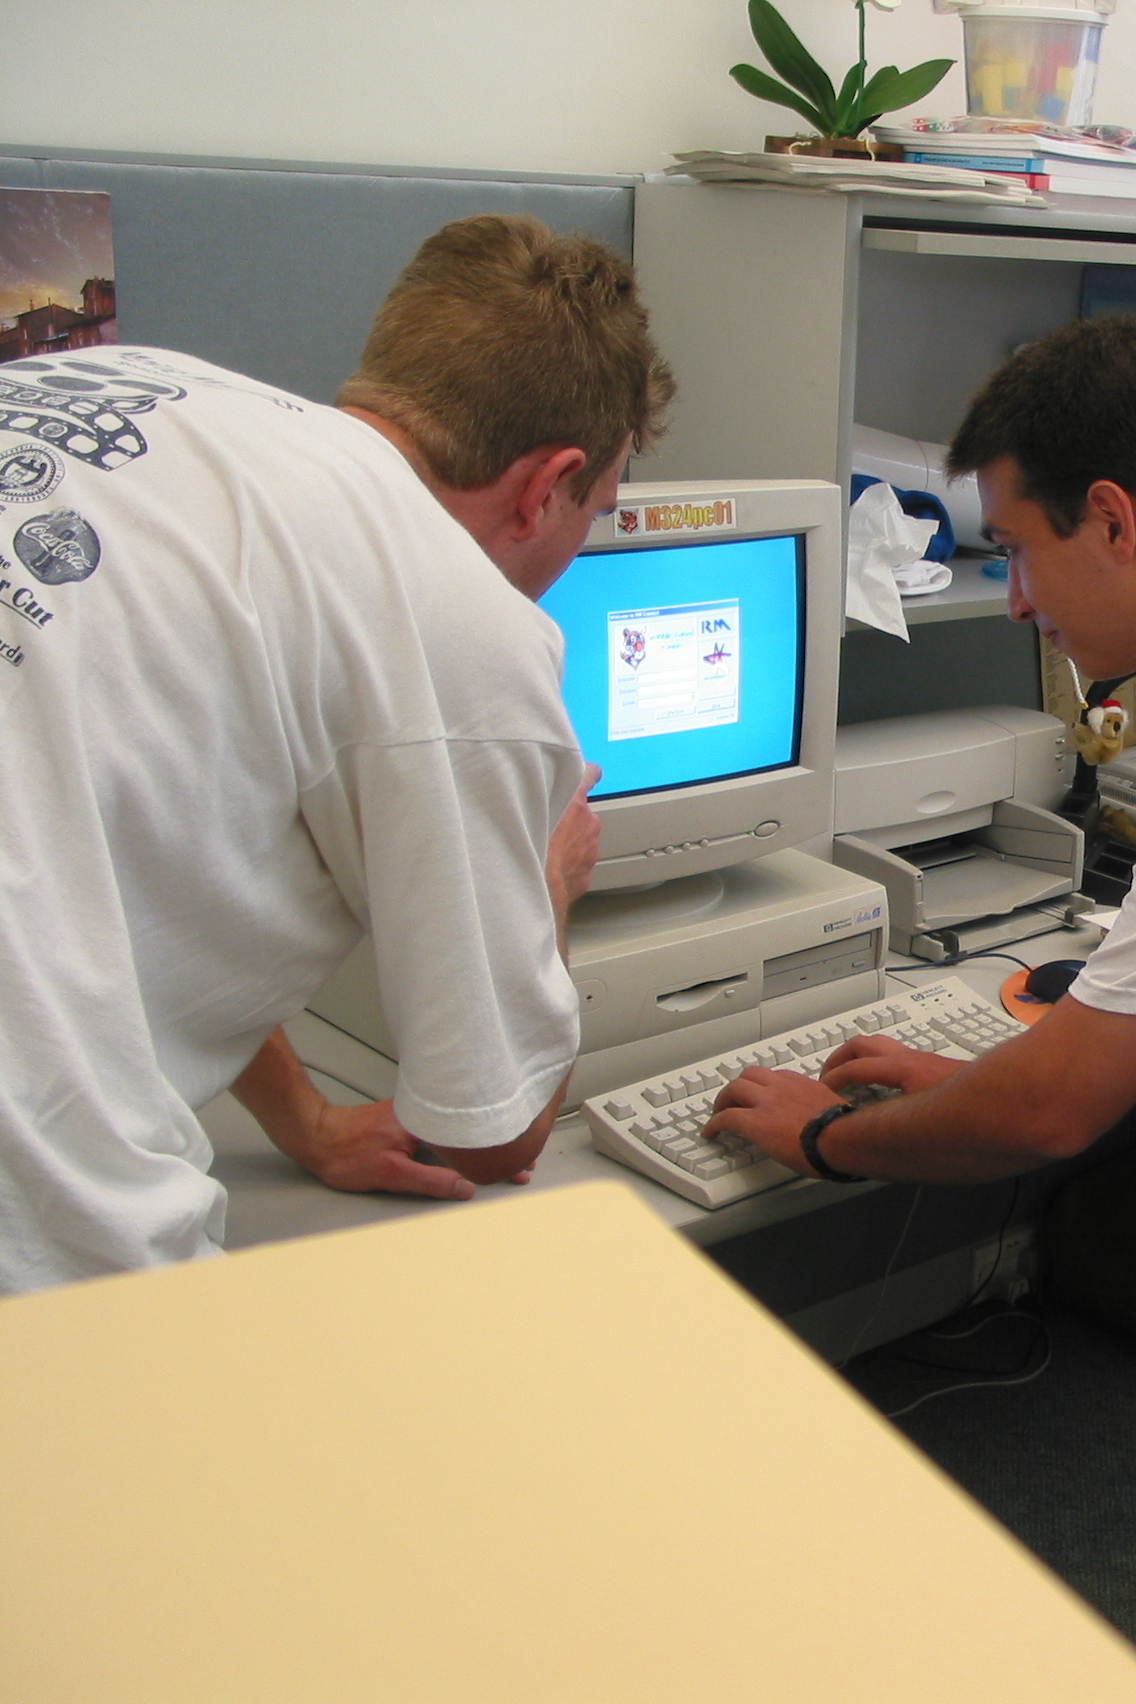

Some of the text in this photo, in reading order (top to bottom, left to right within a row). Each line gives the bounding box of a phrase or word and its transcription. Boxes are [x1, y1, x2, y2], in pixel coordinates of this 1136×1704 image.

[644, 500, 733, 531] M324pc01
[12, 587, 55, 627] Cut
[701, 618, 732, 635] RM
